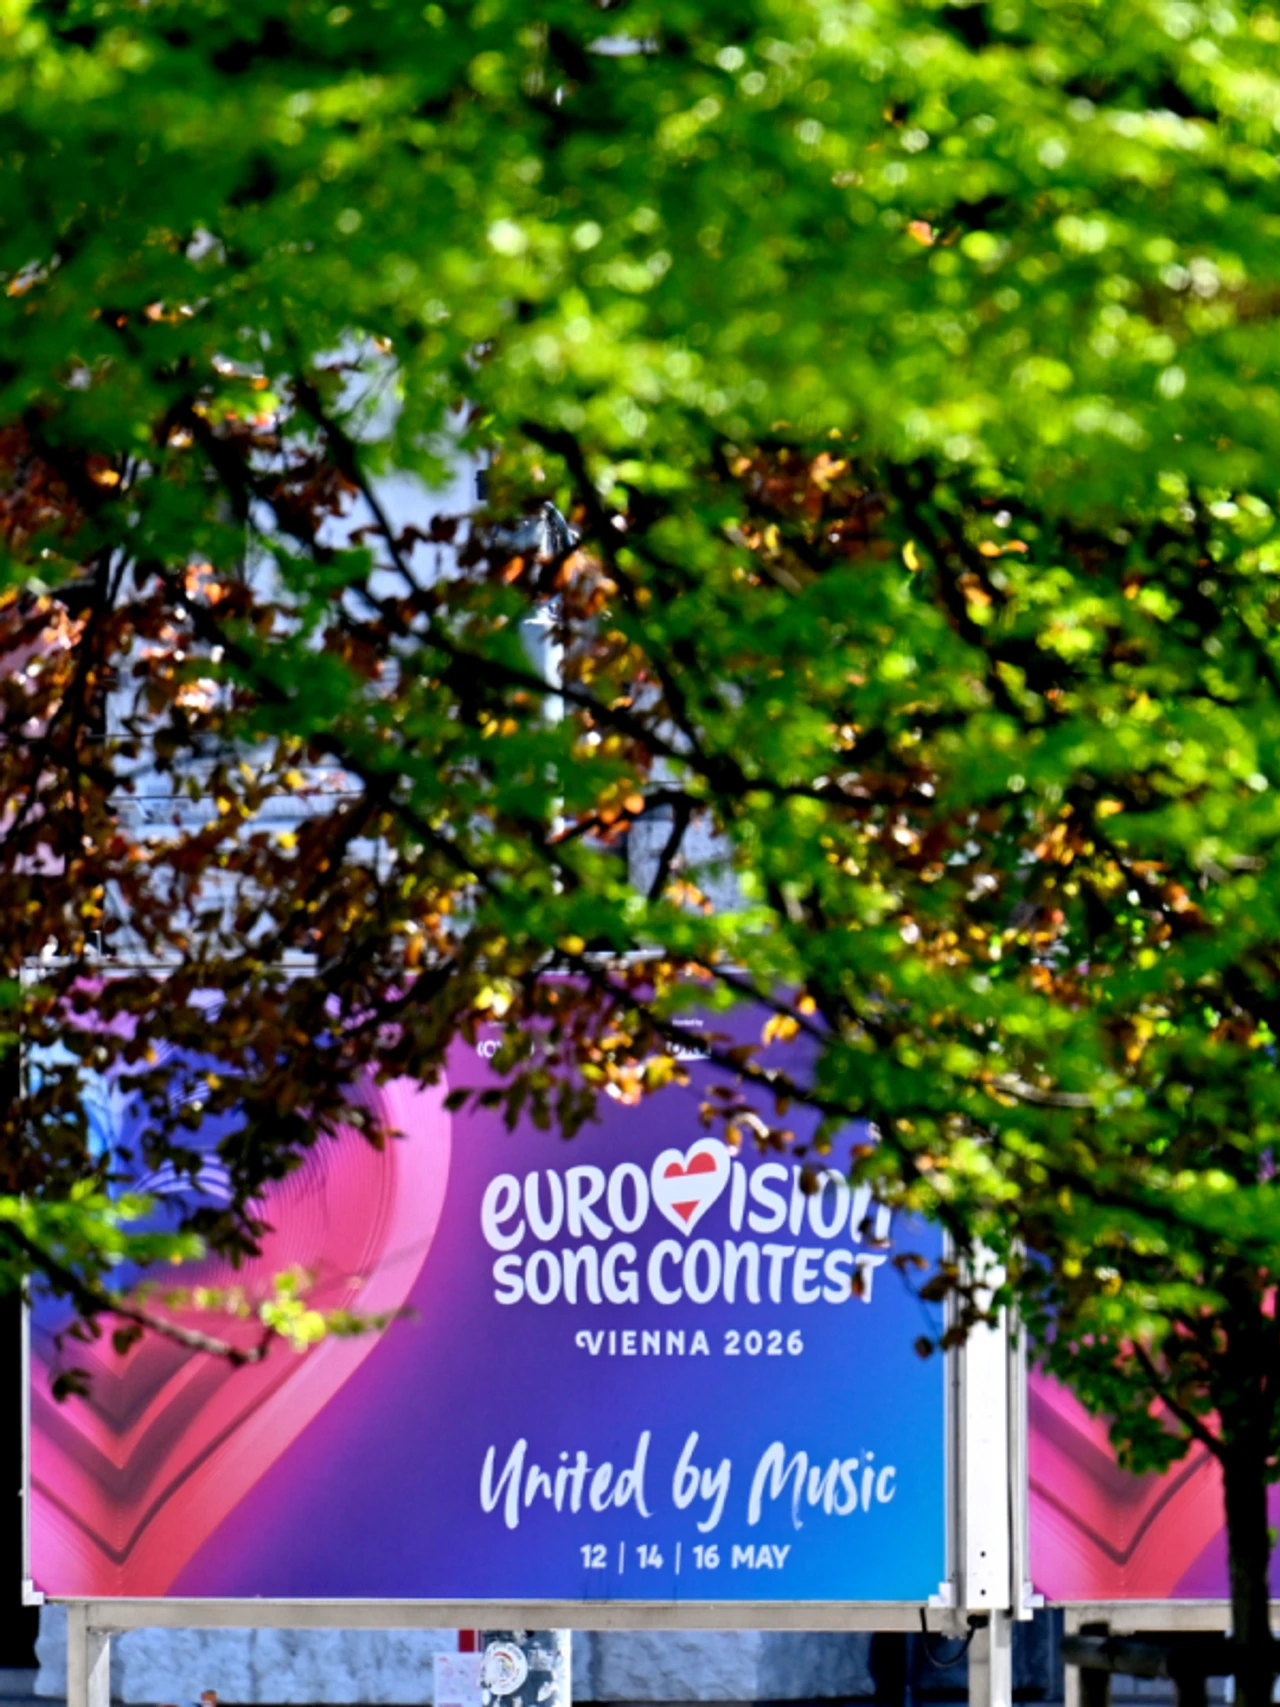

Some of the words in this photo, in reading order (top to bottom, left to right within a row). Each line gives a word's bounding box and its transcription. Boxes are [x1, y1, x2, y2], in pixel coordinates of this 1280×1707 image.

[575, 1329, 710, 1356] VIENNA
[724, 1330, 804, 1356] 2026
[480, 1430, 654, 1529] United
[672, 1431, 731, 1533] by
[747, 1441, 896, 1531] Music
[580, 1544, 607, 1569] 12
[636, 1544, 664, 1569] 14
[693, 1544, 720, 1569] 16
[731, 1544, 791, 1569] MAY
